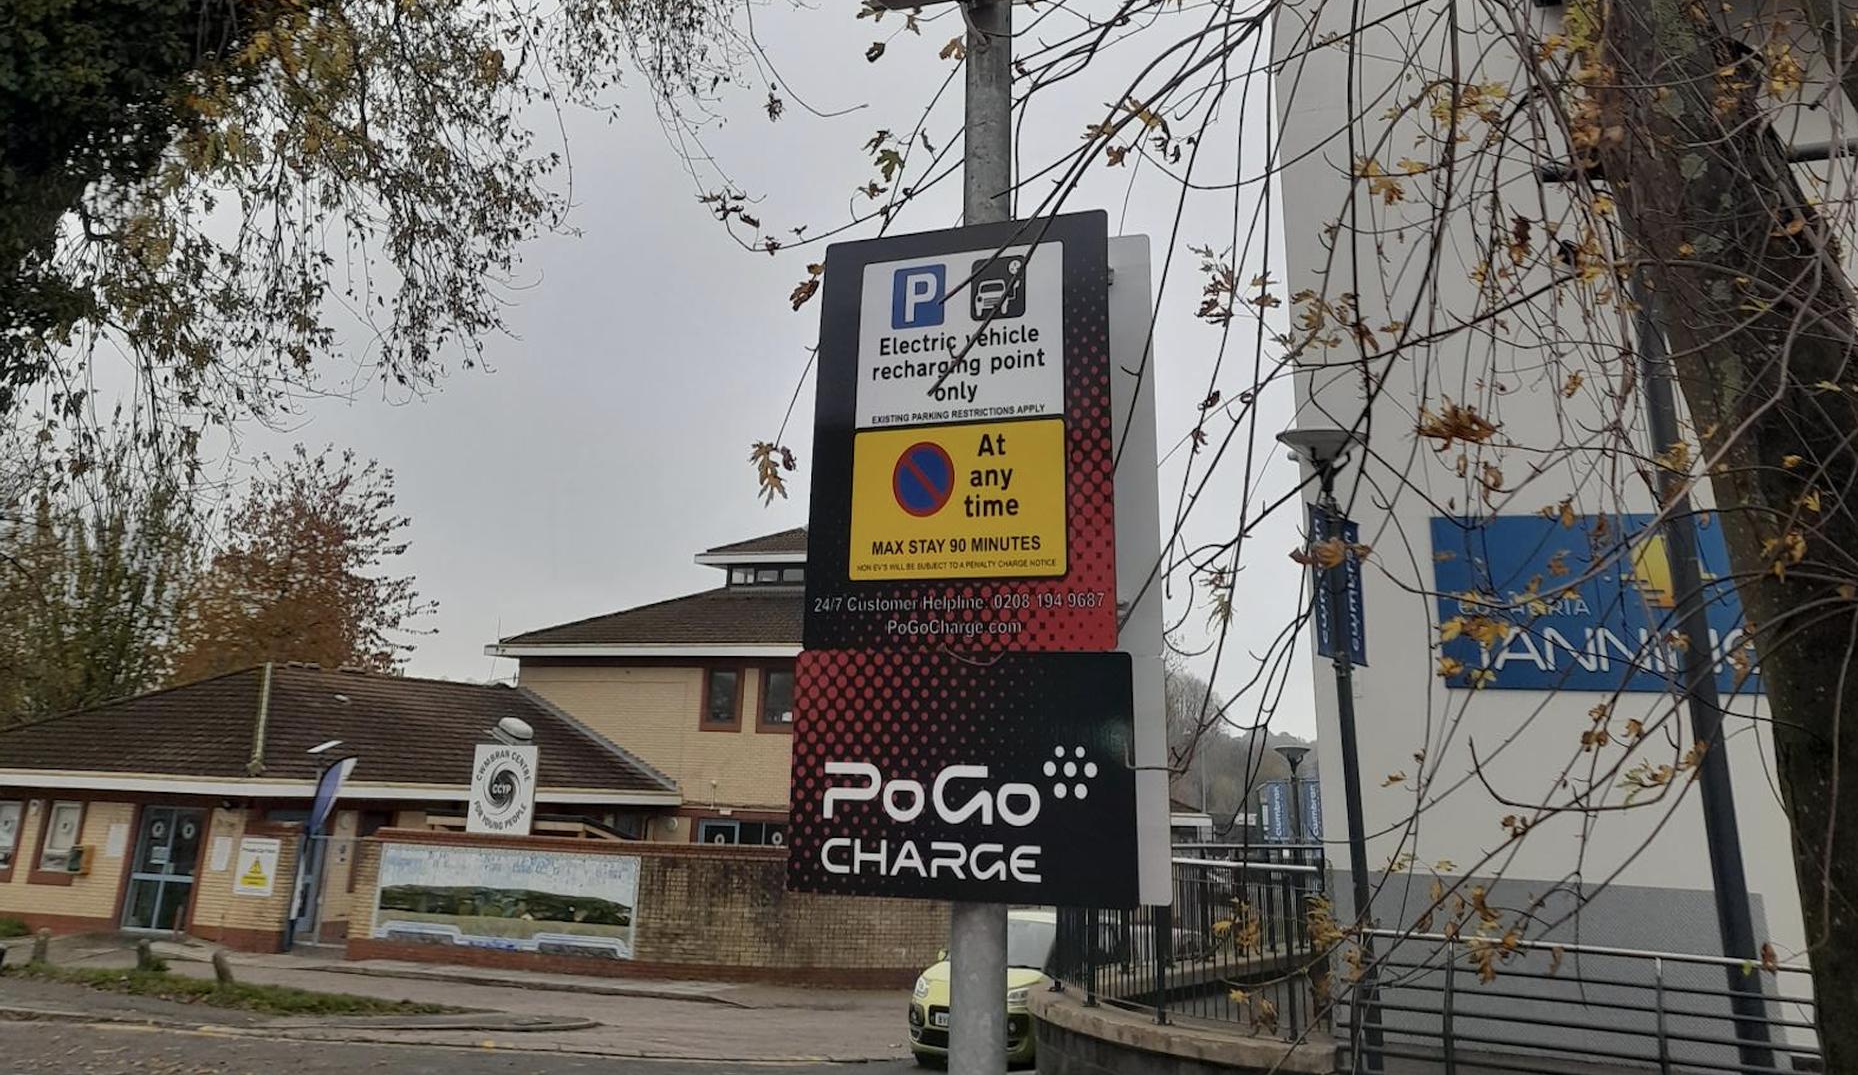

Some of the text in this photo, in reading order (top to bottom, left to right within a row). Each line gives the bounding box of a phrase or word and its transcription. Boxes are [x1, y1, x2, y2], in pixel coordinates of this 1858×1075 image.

[904, 273, 938, 323] P
[879, 332, 957, 356] Electric
[991, 348, 1046, 374] point
[934, 380, 978, 403] only
[872, 404, 1046, 424] EXISTING PARKING RESTRICTIONS APPLY
[977, 433, 1006, 457] At
[970, 468, 1013, 490] any
[964, 494, 1019, 518] time
[871, 535, 1041, 556] MAX STAY 90 MINUTES
[889, 563, 906, 571] WILL
[917, 561, 948, 570] SUBJECT
[949, 561, 959, 570] TO
[966, 559, 996, 569] PENALTY
[998, 559, 1028, 568] CHARGE
[1030, 557, 1057, 567] NOTICE
[814, 596, 843, 613] 24/7
[847, 596, 919, 612] Customer
[994, 593, 1031, 609] 0208
[1037, 592, 1063, 608] 194
[1067, 592, 1105, 608] 9687
[887, 618, 1022, 638] PoGoCharge.com
[511, 751, 532, 782] CENTRE
[822, 761, 1041, 826] PoGo
[821, 837, 1042, 883] CHARGE
